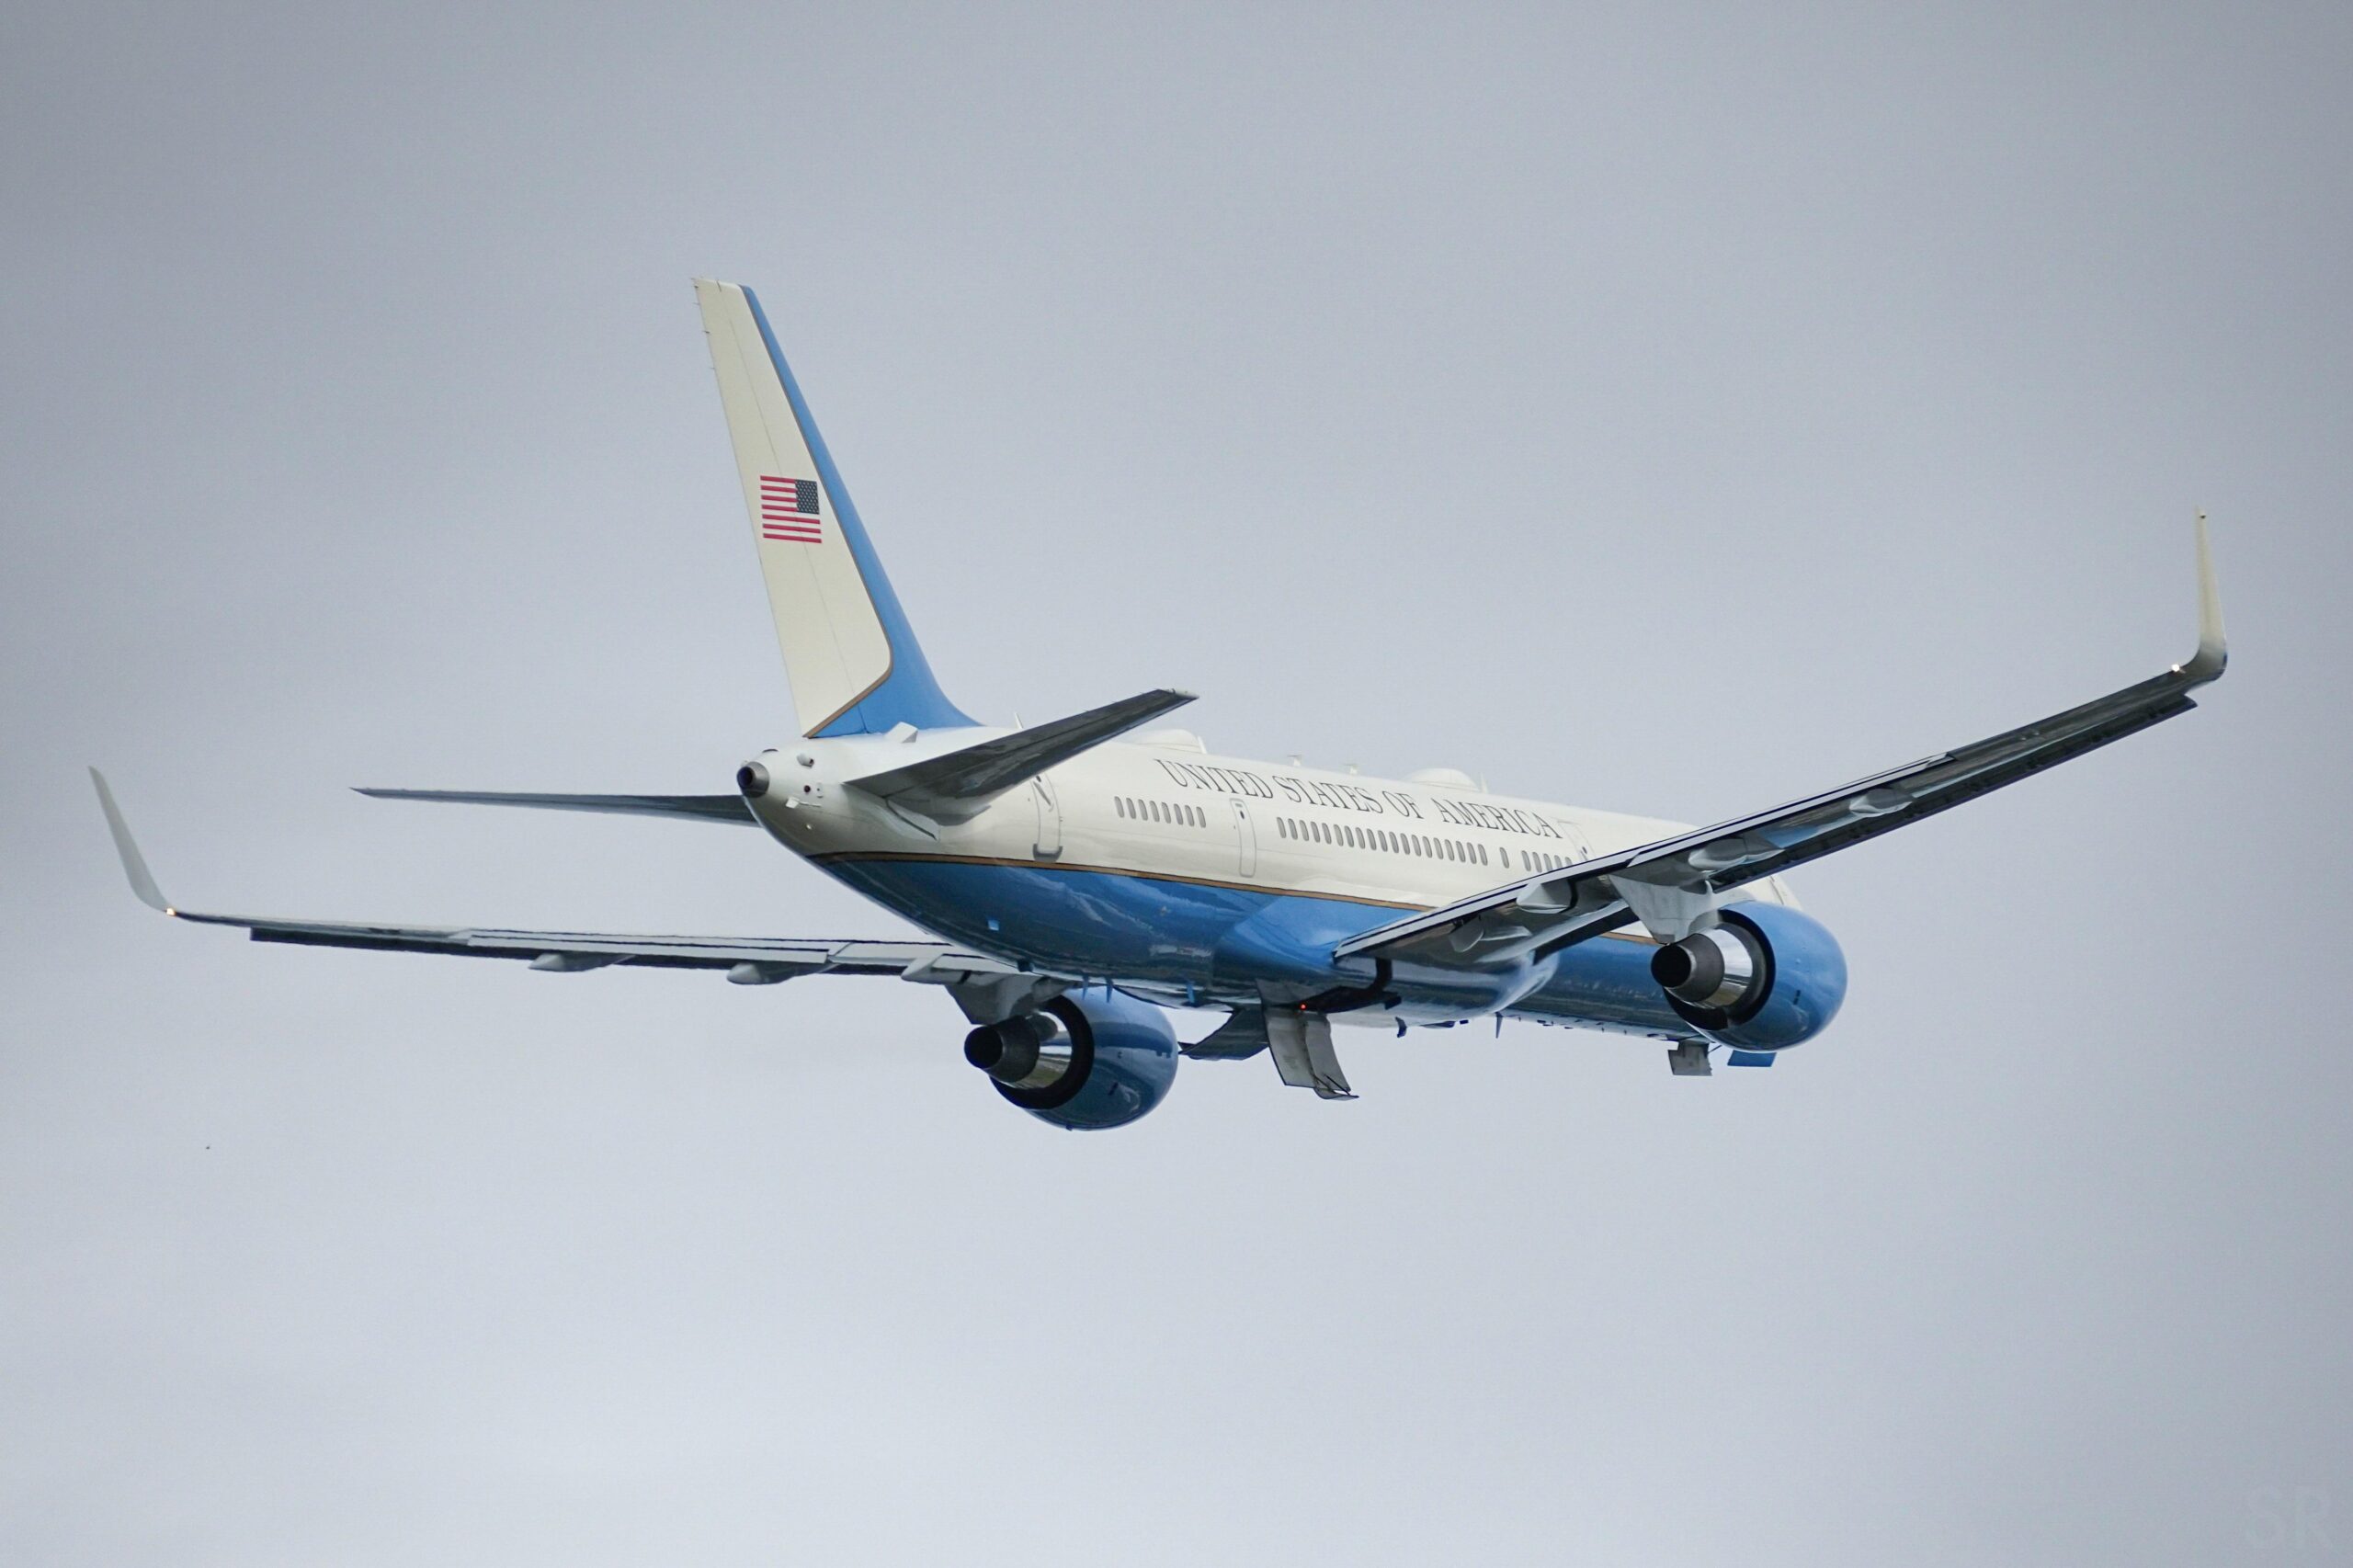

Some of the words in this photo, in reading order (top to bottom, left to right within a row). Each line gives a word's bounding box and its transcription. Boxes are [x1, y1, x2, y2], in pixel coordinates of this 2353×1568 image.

[1154, 759, 1273, 799] UNITED
[1272, 776, 1383, 814] STATES
[1382, 791, 1424, 819] OF
[1430, 798, 1563, 838] AMERICA
